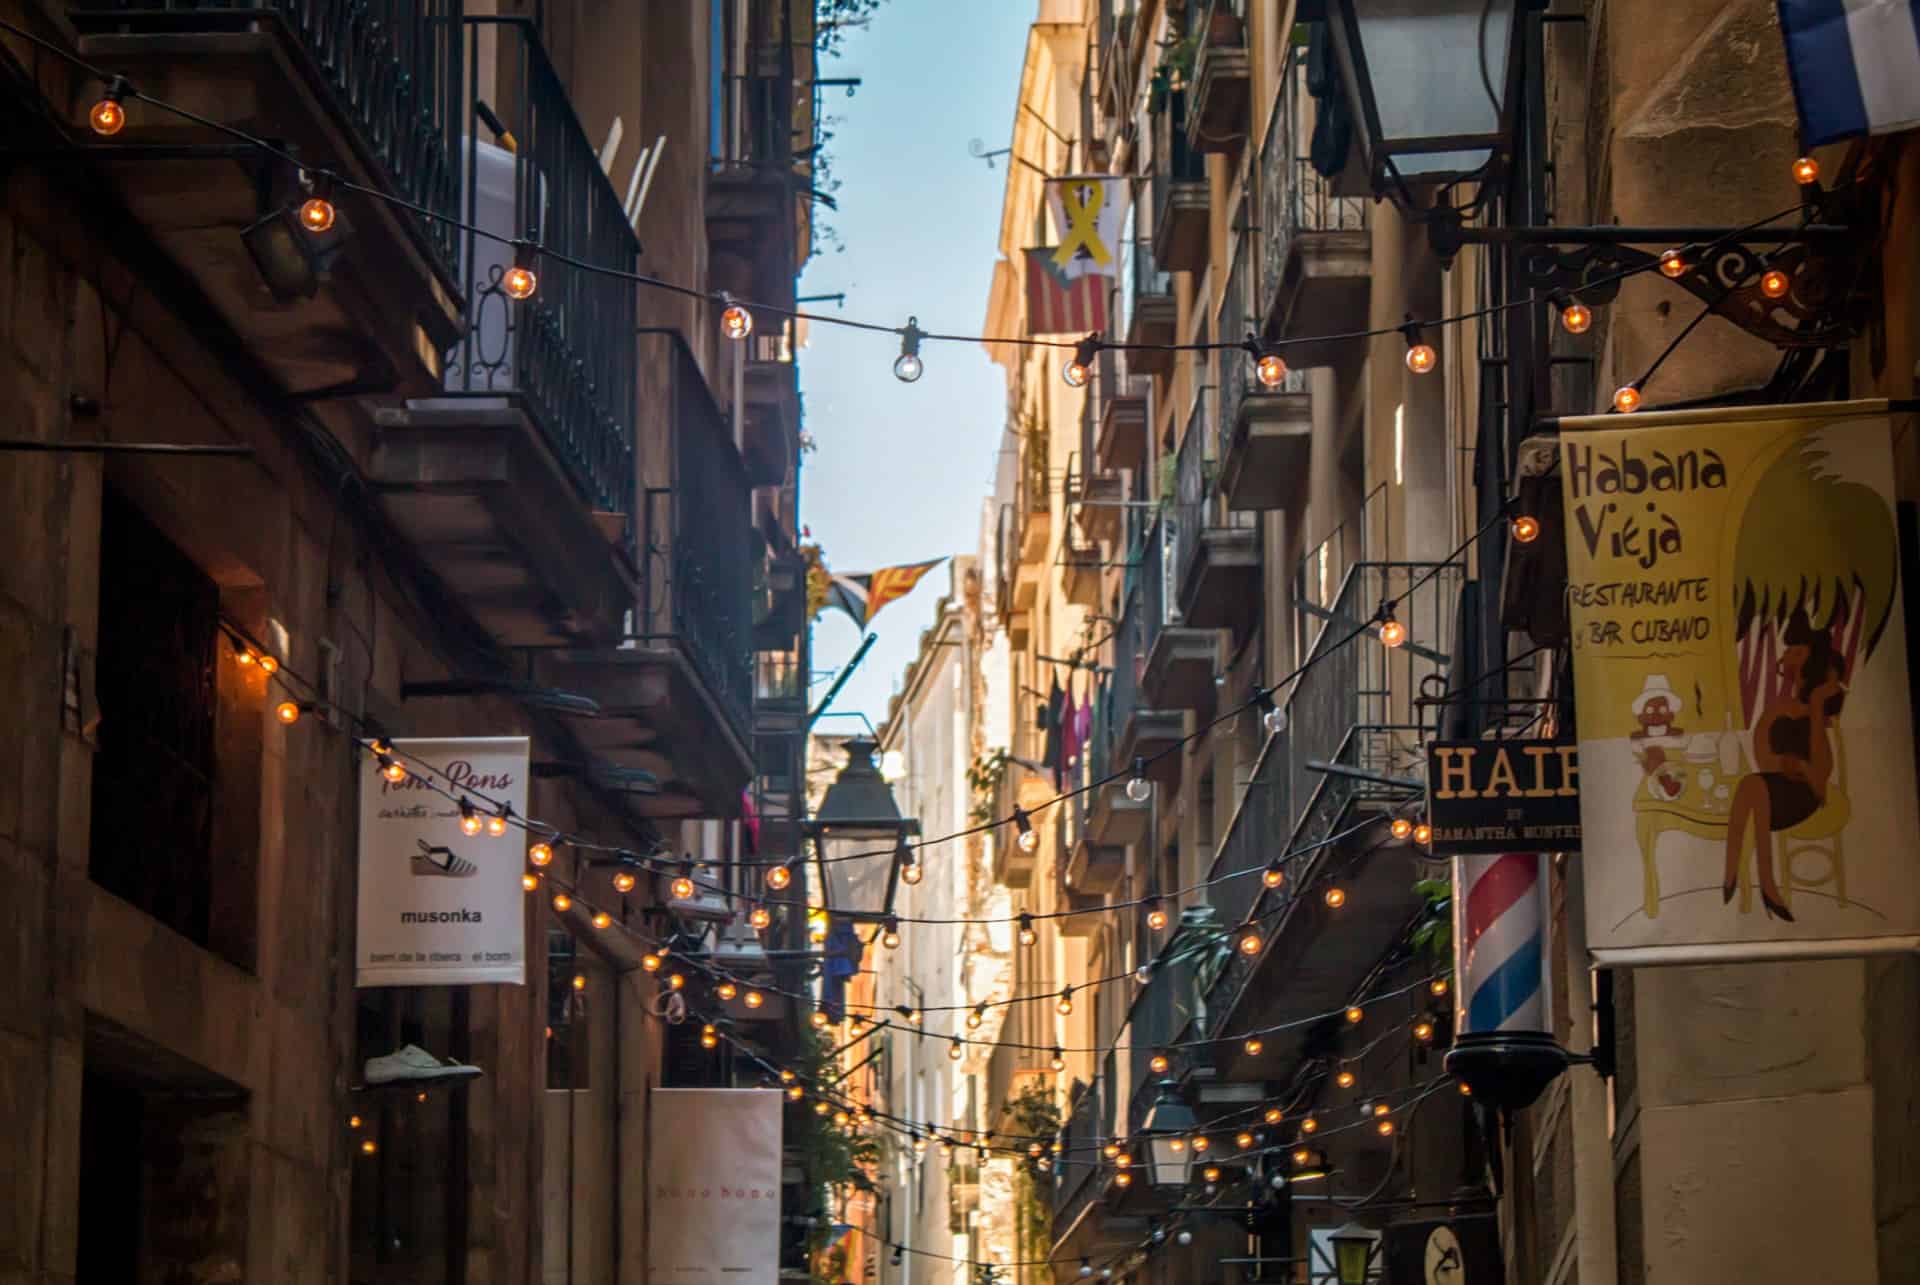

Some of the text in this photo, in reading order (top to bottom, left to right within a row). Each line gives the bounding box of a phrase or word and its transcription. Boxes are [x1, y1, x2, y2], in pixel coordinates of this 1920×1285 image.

[1567, 440, 1728, 498] Habana
[1573, 502, 1682, 570] Vieja
[1569, 577, 1709, 608] RESTAURANTE
[1587, 619, 1624, 646] BAR
[1630, 615, 1711, 645] CUBANO
[446, 760, 514, 793] Pons
[401, 909, 483, 924] musonka
